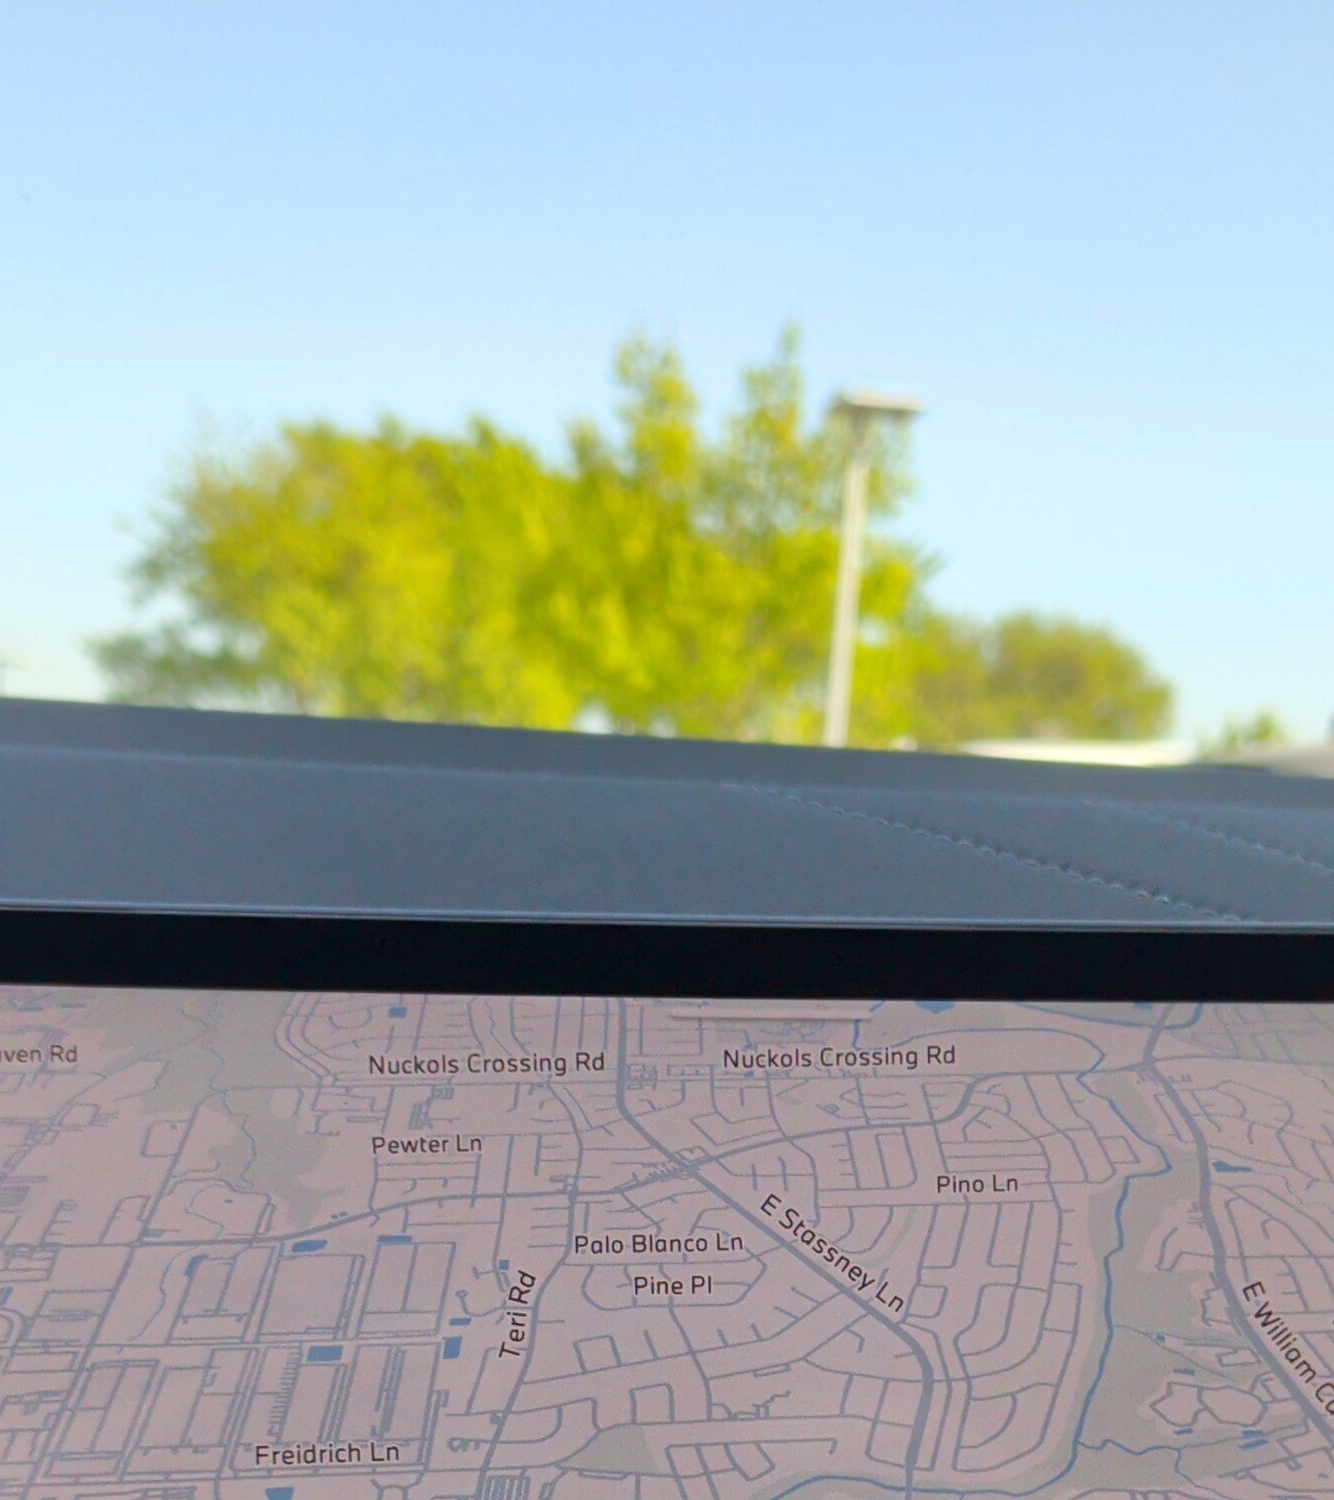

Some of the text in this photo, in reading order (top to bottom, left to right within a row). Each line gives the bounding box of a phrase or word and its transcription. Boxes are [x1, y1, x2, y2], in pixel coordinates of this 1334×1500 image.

[48, 1044, 79, 1065] Rd
[368, 1051, 606, 1078] Nuckols Crossing Rd
[722, 1044, 957, 1072] Nuckols Crossing Rd
[371, 1132, 483, 1156] Pewter Ln
[936, 1173, 1019, 1195] Pino Ln
[574, 1232, 744, 1255] Palo Blanco Ln
[760, 1193, 905, 1313] E Stassney Ln
[633, 1274, 713, 1297] Pine Pl
[498, 1269, 538, 1361] Teri Rd
[1242, 1281, 1266, 1302] E
[1254, 1301, 1317, 1385] William
[255, 1441, 400, 1466] Freidrich Ln
